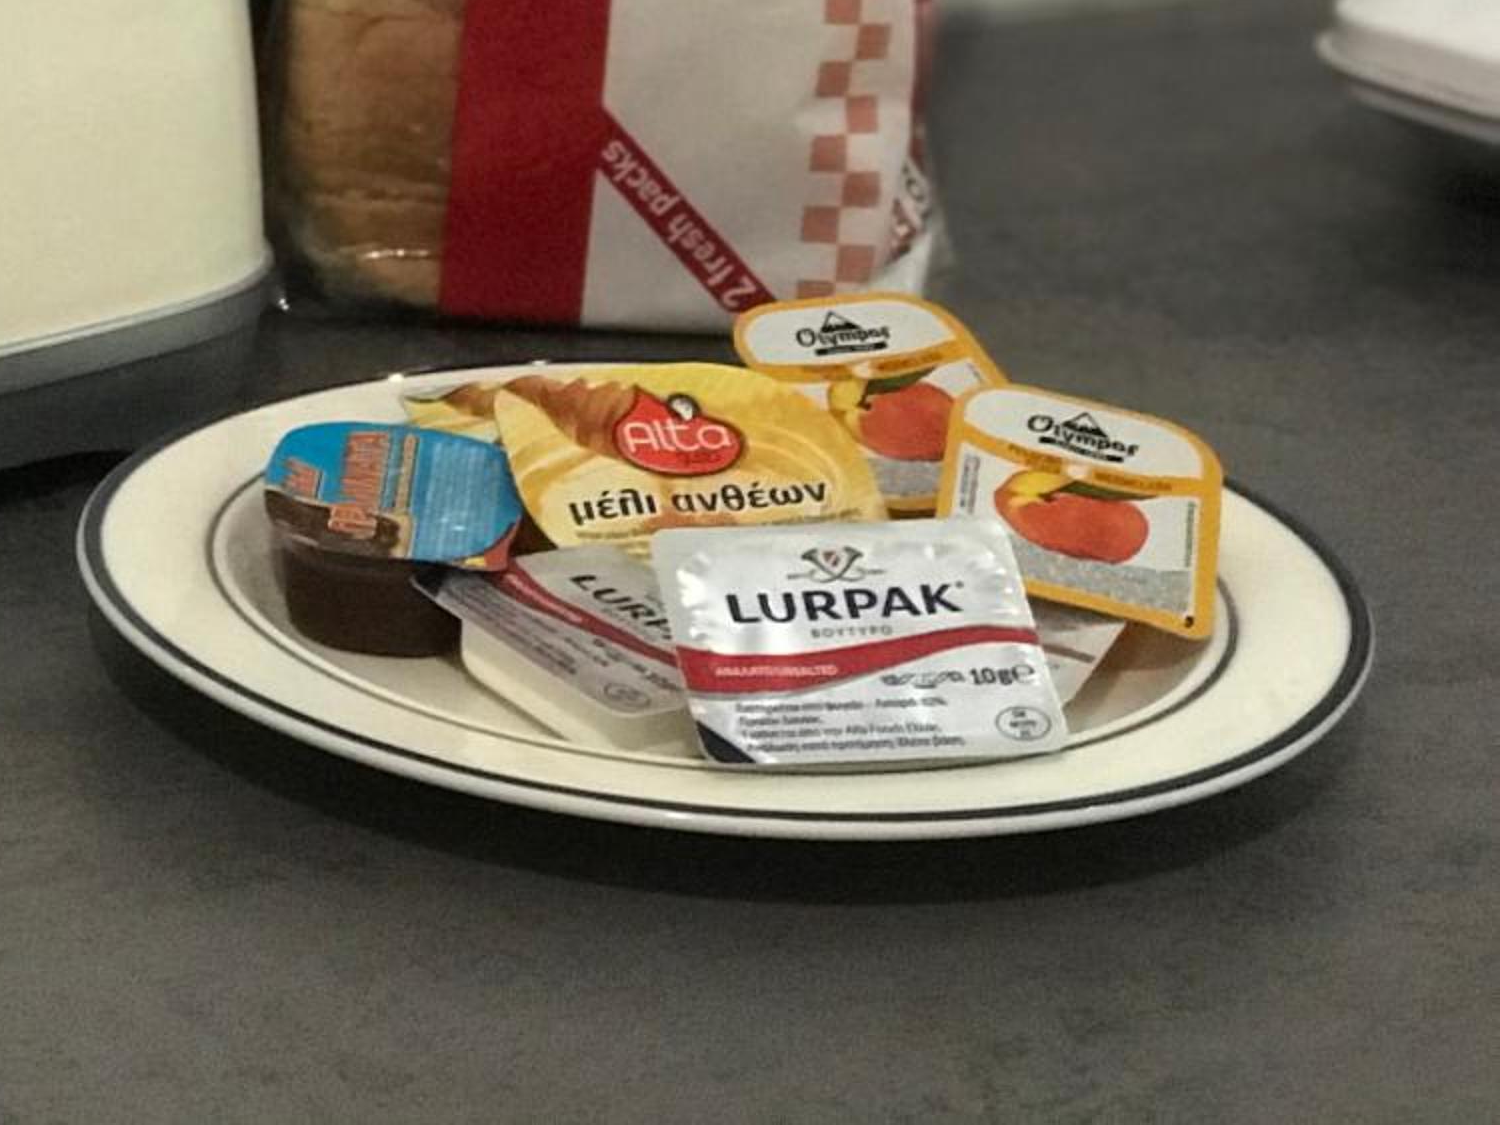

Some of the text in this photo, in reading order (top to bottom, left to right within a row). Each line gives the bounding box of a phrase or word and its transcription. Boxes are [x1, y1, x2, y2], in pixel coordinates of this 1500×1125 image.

[601, 140, 757, 308] 2 fresh packs
[622, 417, 734, 454] Alta
[568, 479, 827, 526] μέλι ανθέων
[725, 583, 965, 625] LURPAK
